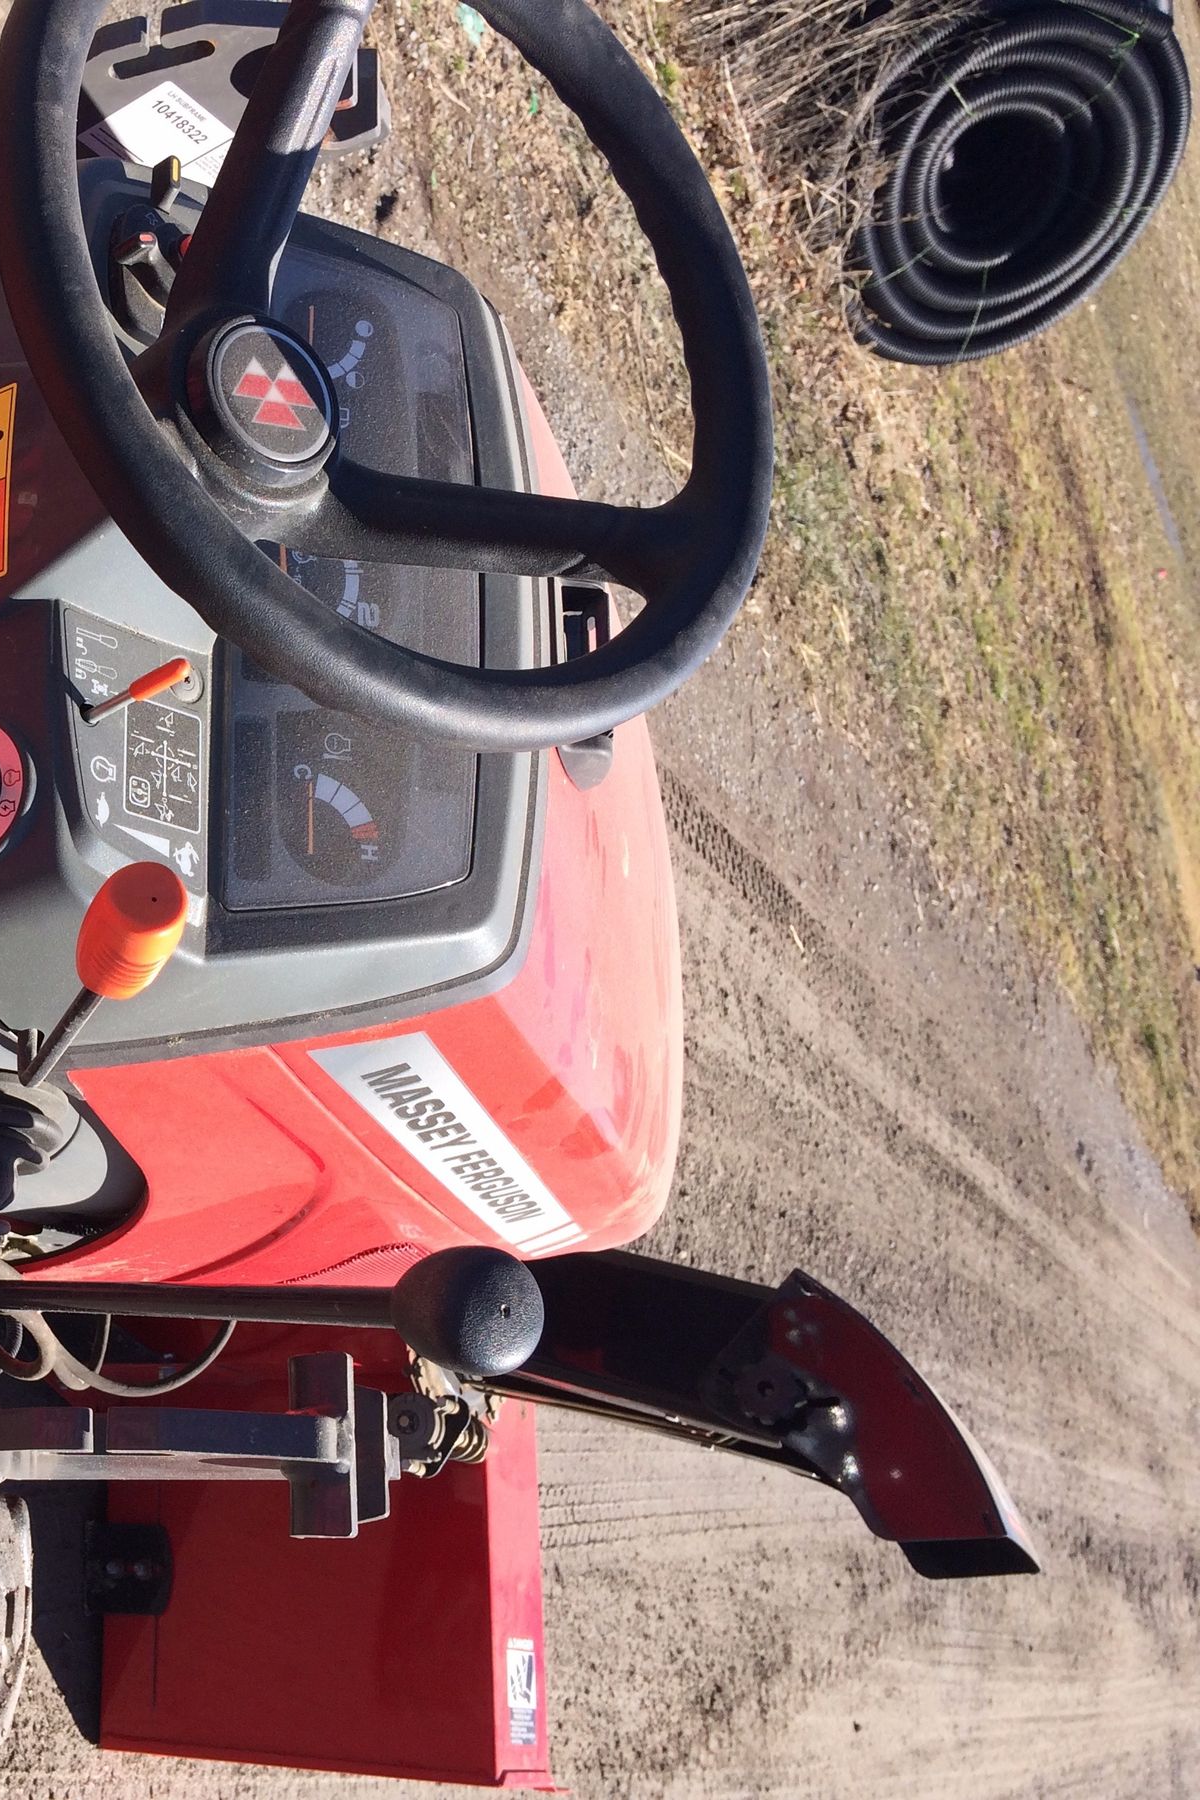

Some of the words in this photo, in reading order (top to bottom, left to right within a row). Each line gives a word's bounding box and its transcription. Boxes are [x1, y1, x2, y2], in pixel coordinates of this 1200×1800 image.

[151, 99, 209, 145] 10418322
[293, 764, 312, 780] C
[360, 844, 379, 861] H
[360, 1062, 477, 1151] MASSEY
[442, 1149, 545, 1224] FERGUSON
